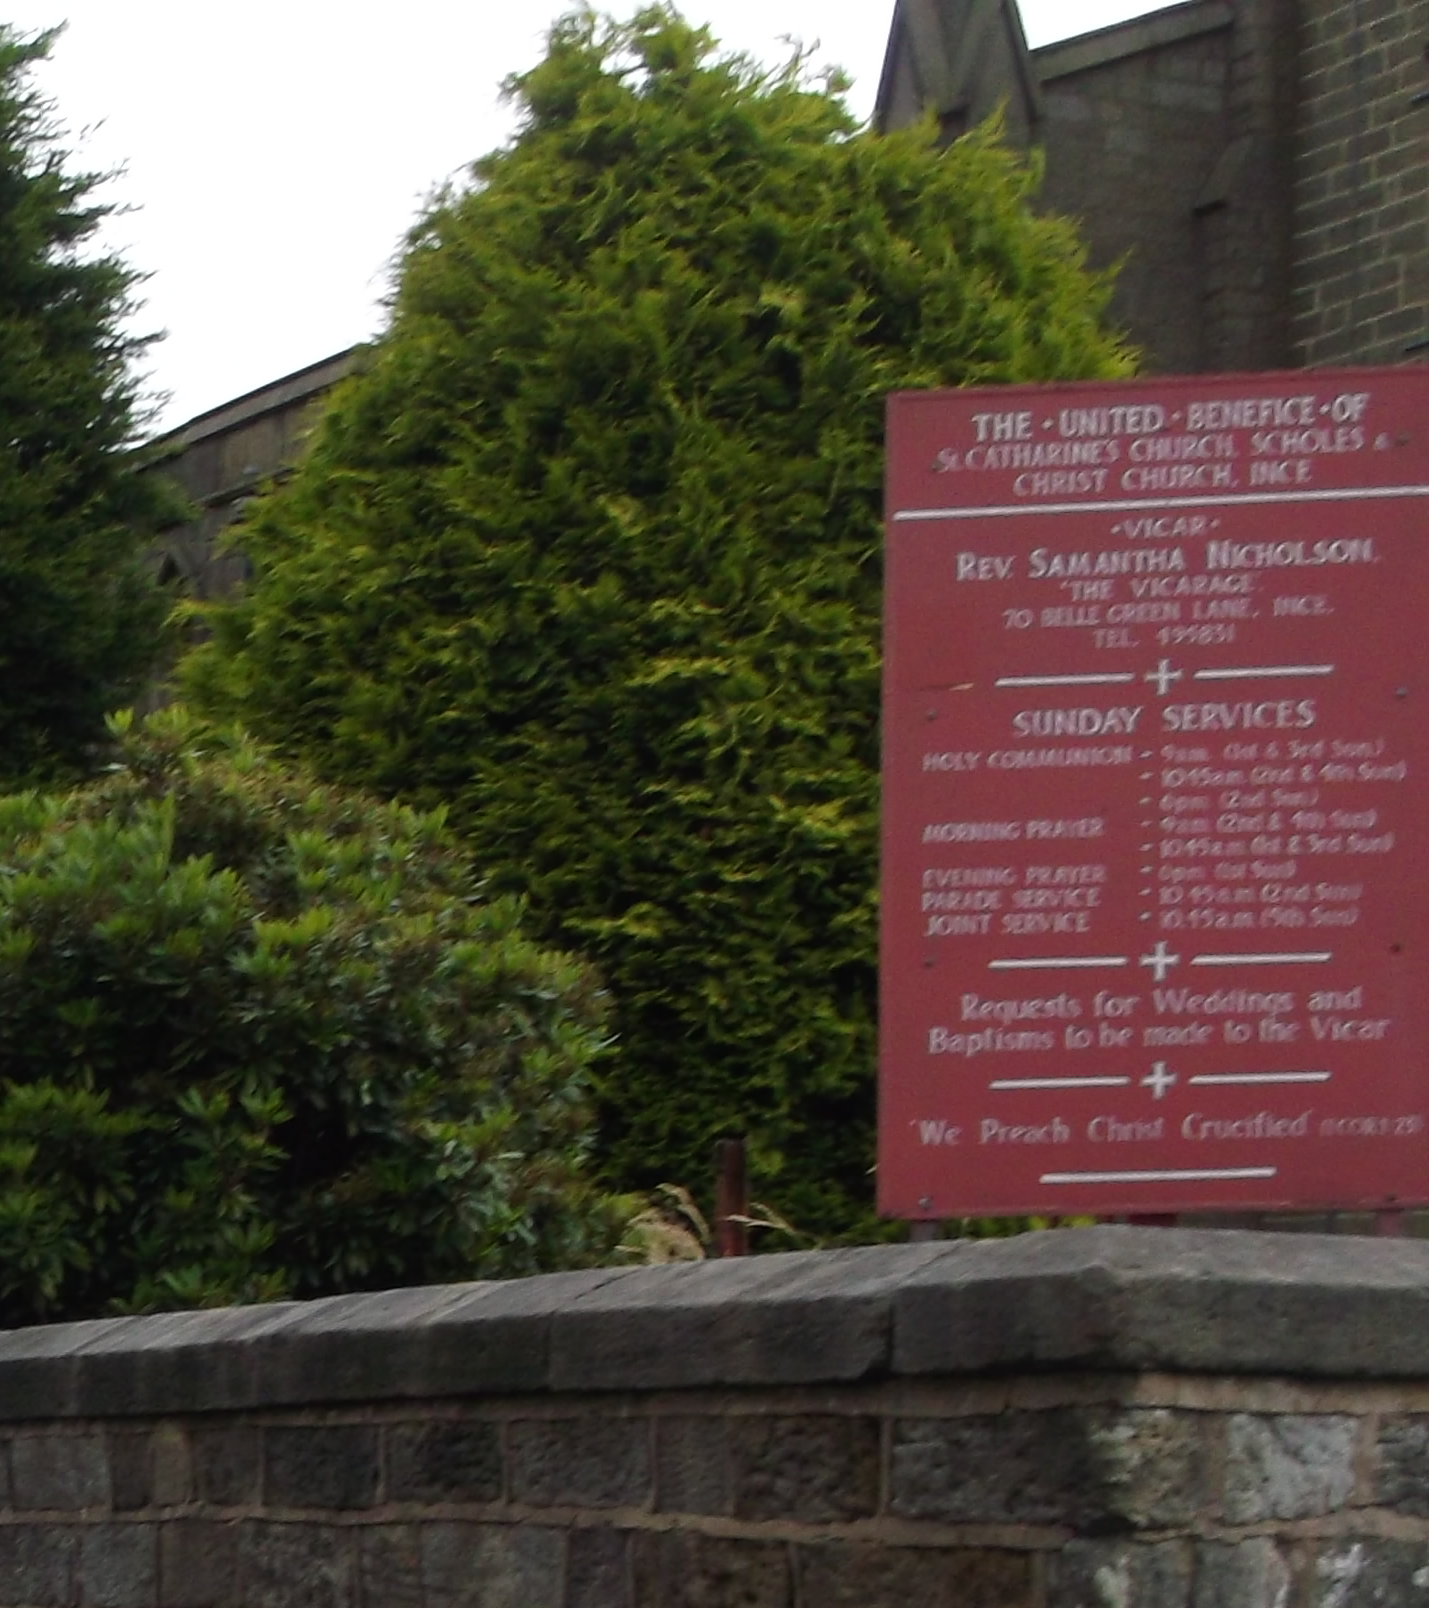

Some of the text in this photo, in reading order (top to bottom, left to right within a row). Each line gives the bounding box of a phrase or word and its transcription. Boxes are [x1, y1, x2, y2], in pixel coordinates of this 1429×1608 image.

[972, 392, 1370, 442] THE UNITED BENEFICE OF
[1251, 427, 1364, 455] SCHOLES
[1013, 468, 1108, 496] CHRIST
[1249, 458, 1312, 486] INCE
[1123, 516, 1207, 539] VICAR
[1002, 607, 1034, 629] 70
[1040, 604, 1099, 627] BELLE
[1106, 601, 1180, 623] GREEN
[1012, 699, 1318, 738] SUNDAY SERVICES
[922, 752, 981, 772] HOLY
[987, 746, 1134, 769] COMMUNION
[922, 821, 1021, 844] MORNING
[1025, 817, 1104, 839] PRAYER
[923, 867, 1018, 887] EVENING
[1025, 864, 1107, 884] PRAYER
[922, 889, 1002, 912] PARADE
[1012, 887, 1102, 908] SERVICE
[925, 914, 993, 936] JOINT
[1001, 911, 1090, 935] SERVICE
[961, 985, 1363, 1024] Requests for Weddings and
[928, 1016, 1391, 1057] Baptisms to be made to the Vicar
[919, 1119, 962, 1145] We
[980, 1116, 1071, 1144] Preach
[1088, 1116, 1165, 1143] Christ
[1181, 1109, 1313, 1141] Crucified
